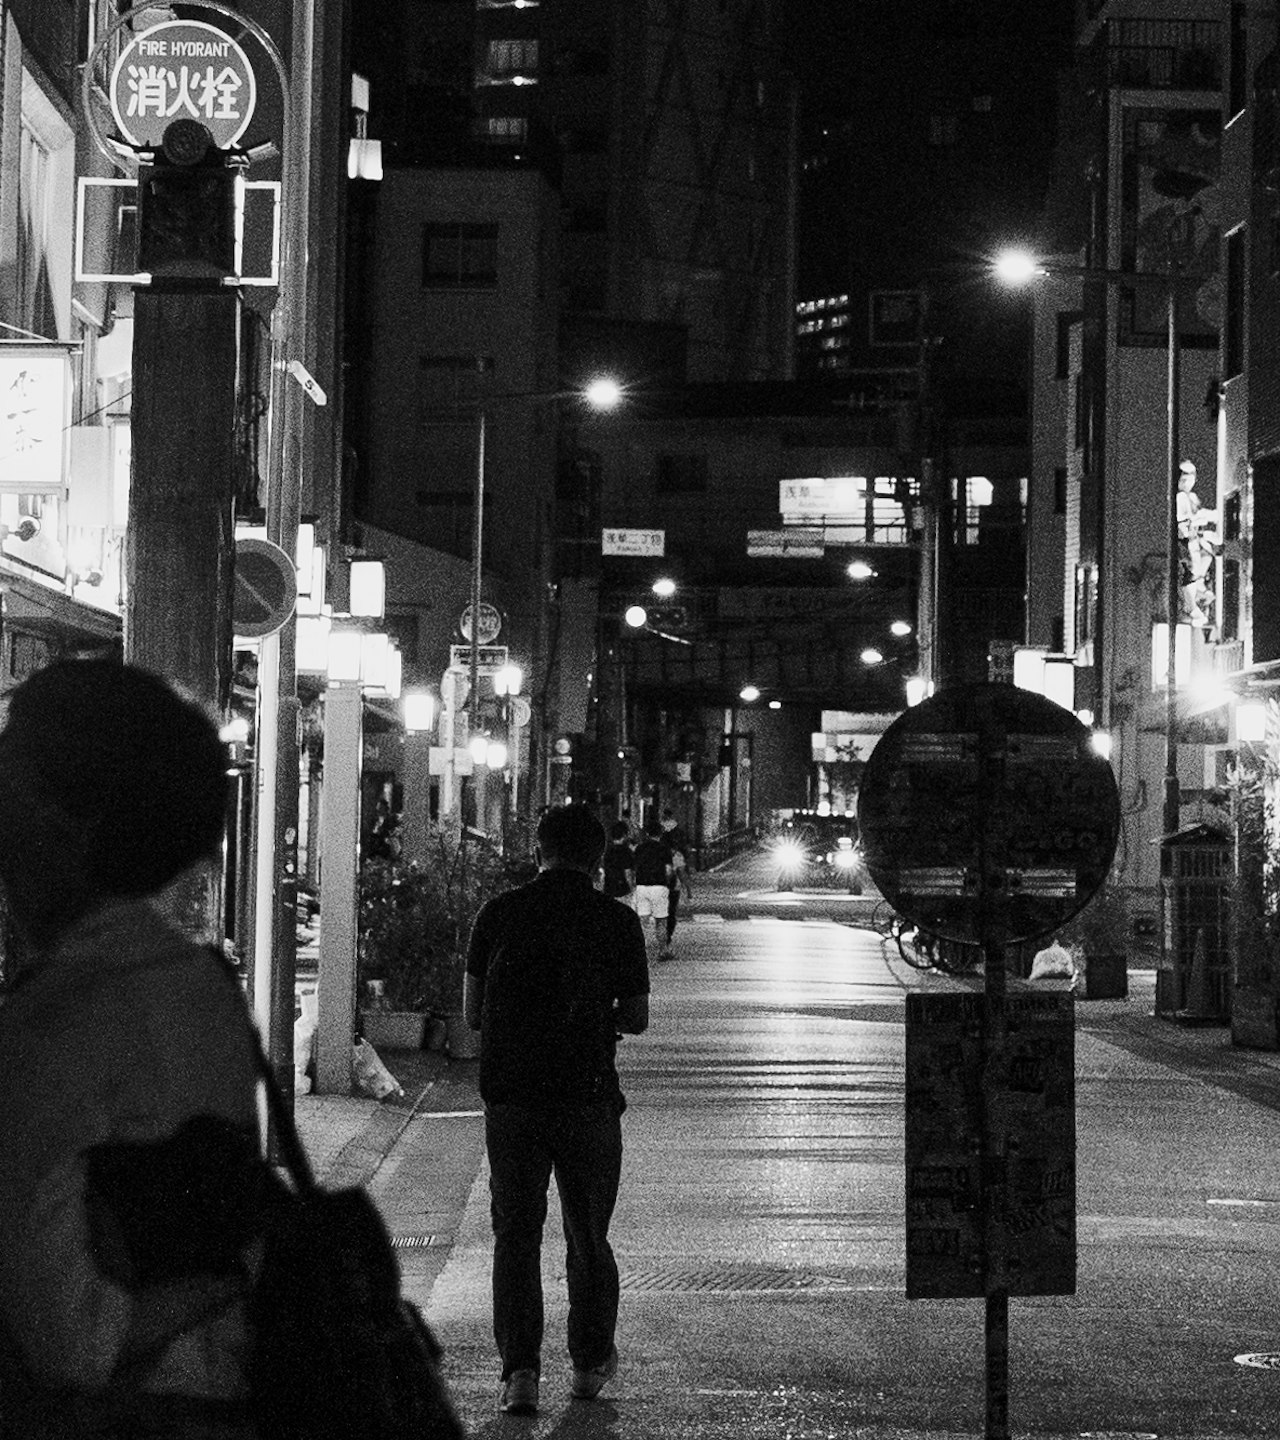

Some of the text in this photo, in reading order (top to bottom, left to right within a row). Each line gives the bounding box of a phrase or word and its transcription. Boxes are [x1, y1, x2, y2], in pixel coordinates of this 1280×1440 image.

[139, 40, 231, 58] FIRE HYDRANT
[126, 65, 243, 120] 消火栓
